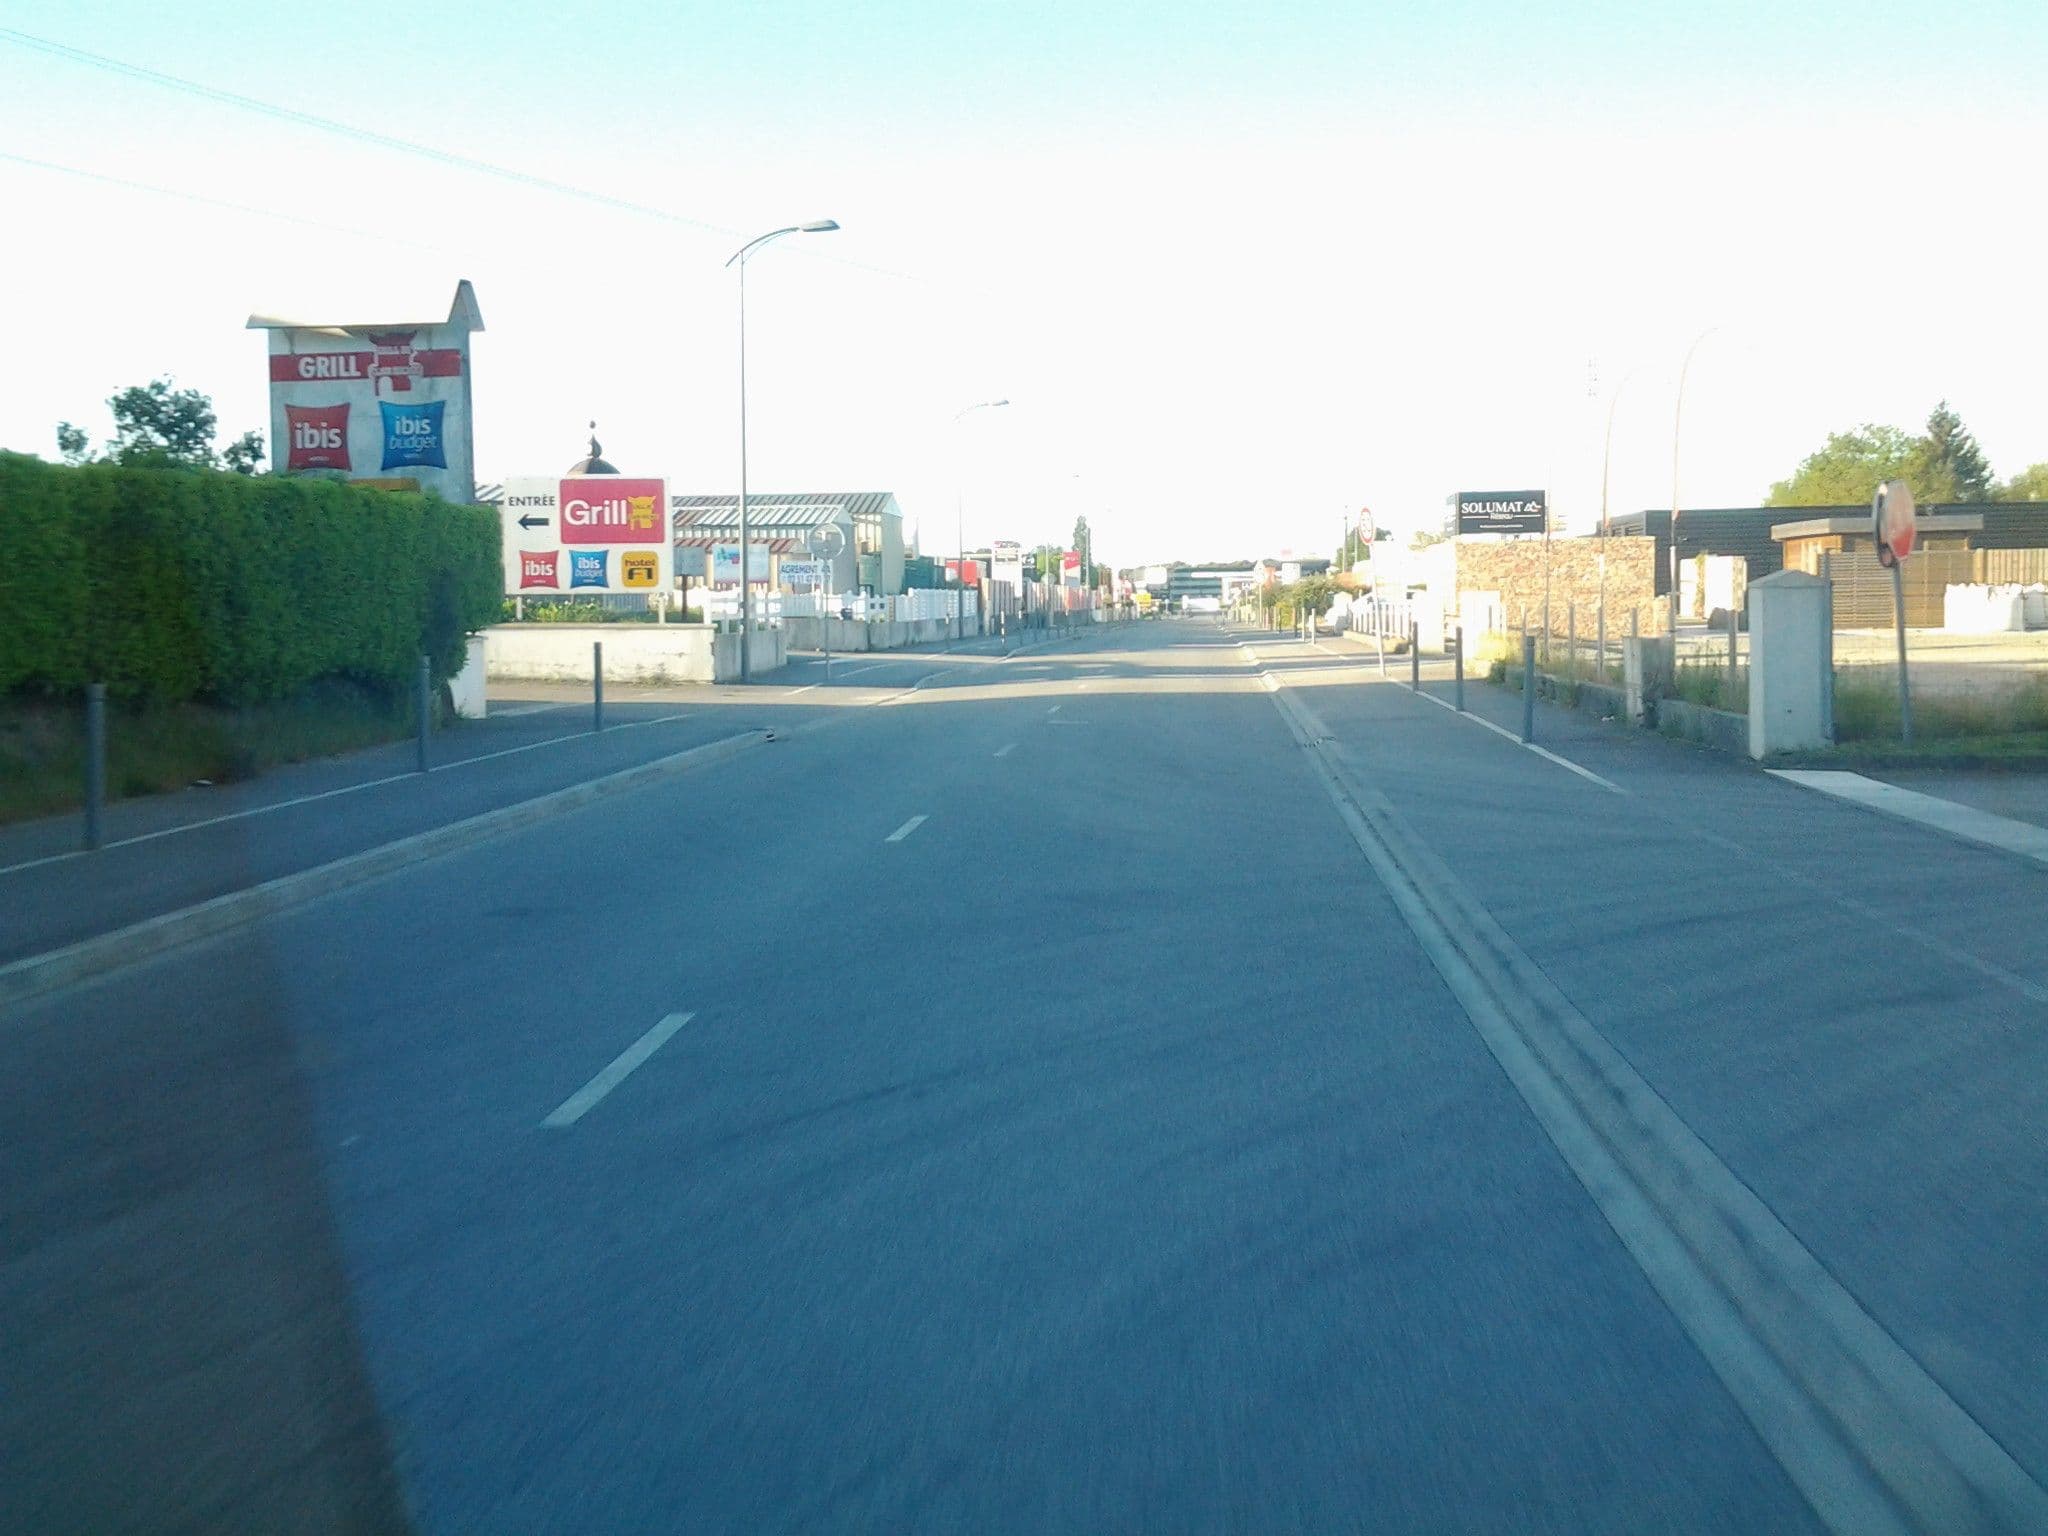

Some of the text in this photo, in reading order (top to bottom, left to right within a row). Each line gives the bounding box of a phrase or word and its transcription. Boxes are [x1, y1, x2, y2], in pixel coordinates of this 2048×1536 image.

[299, 355, 361, 378] GRILL
[395, 415, 432, 435] ibis
[295, 422, 342, 448] ibis
[389, 433, 437, 451] budget
[508, 494, 555, 506] ENTRÉE
[1461, 501, 1523, 514] SOLUMAT
[564, 499, 627, 525] Grill
[525, 560, 554, 576] ibis
[577, 557, 603, 569] ibis
[624, 559, 656, 567] hotel
